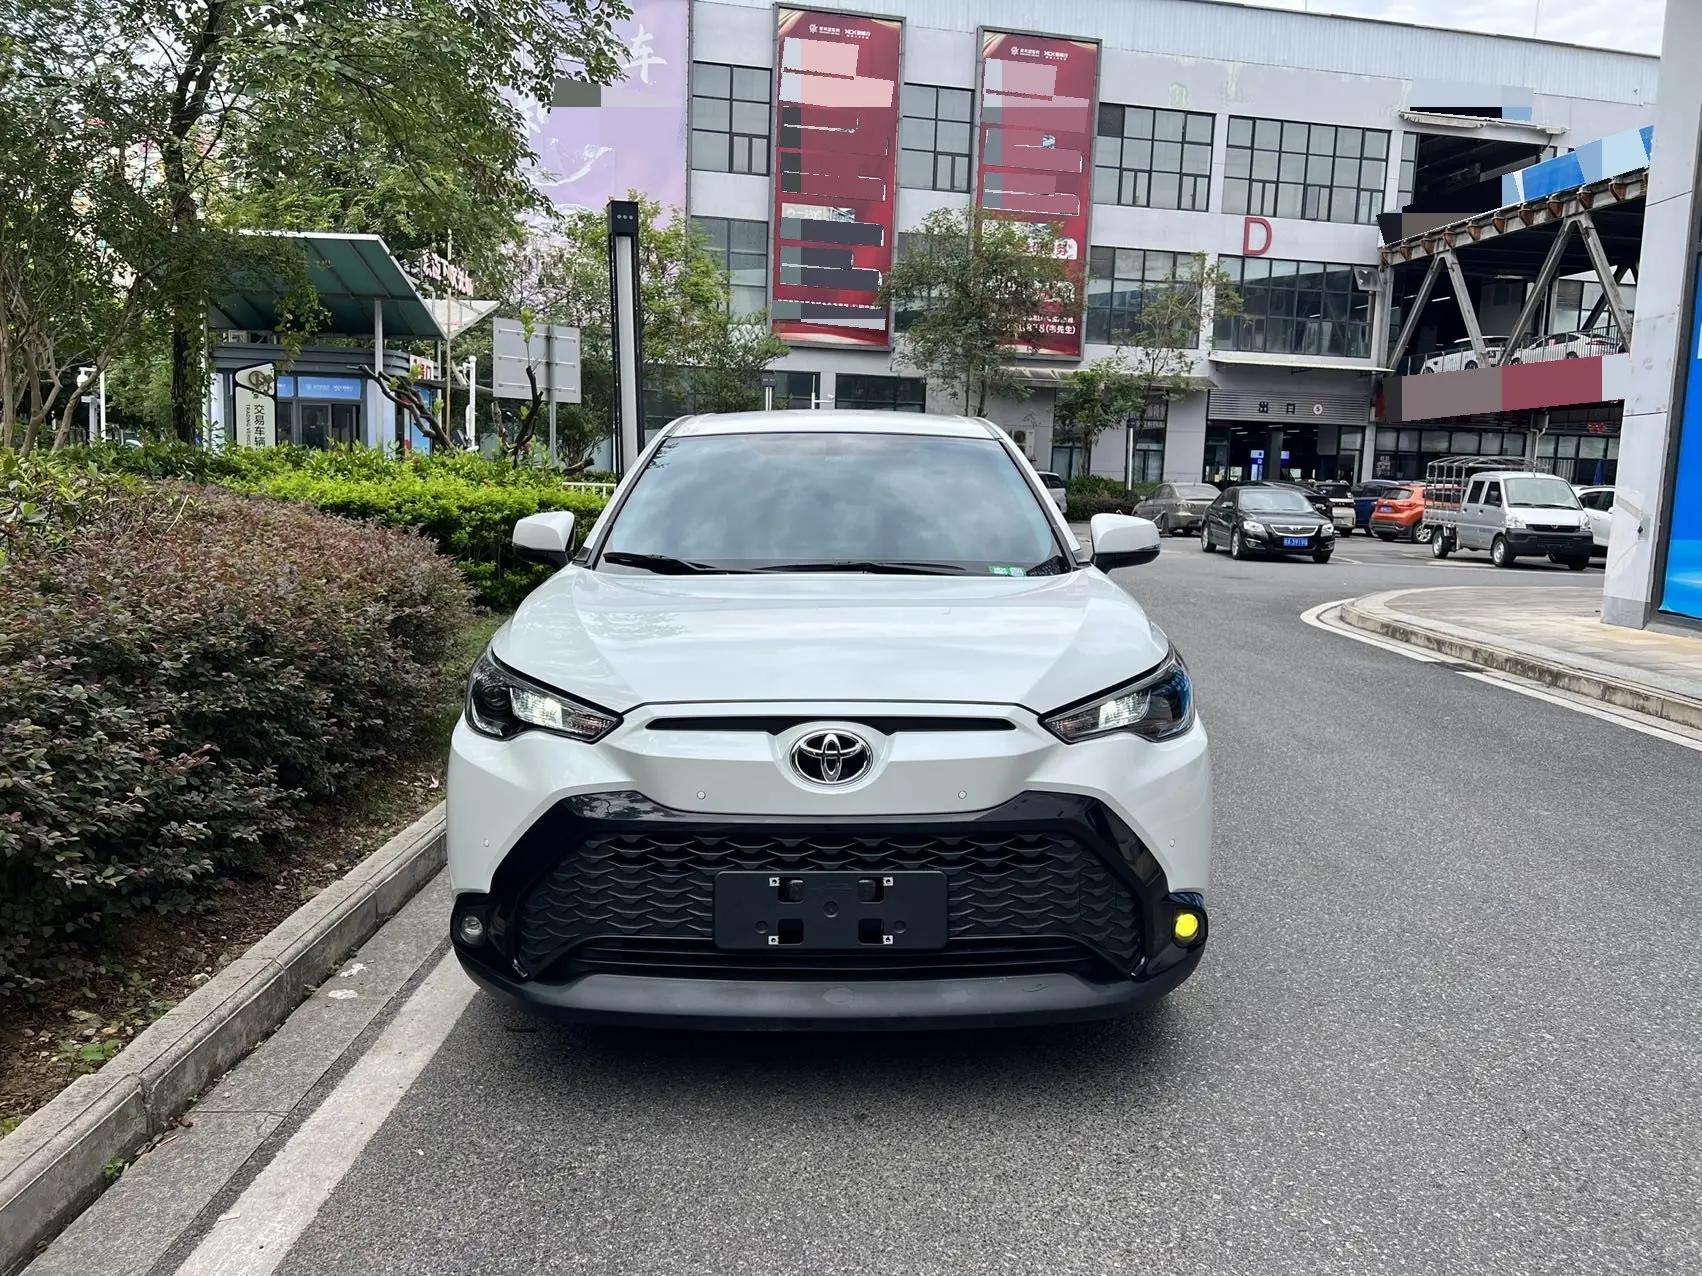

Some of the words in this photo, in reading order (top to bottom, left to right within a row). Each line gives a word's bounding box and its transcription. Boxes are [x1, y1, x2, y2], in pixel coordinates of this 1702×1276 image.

[622, 23, 668, 84] 车
[1243, 216, 1273, 256] D
[1258, 401, 1296, 415] 出口
